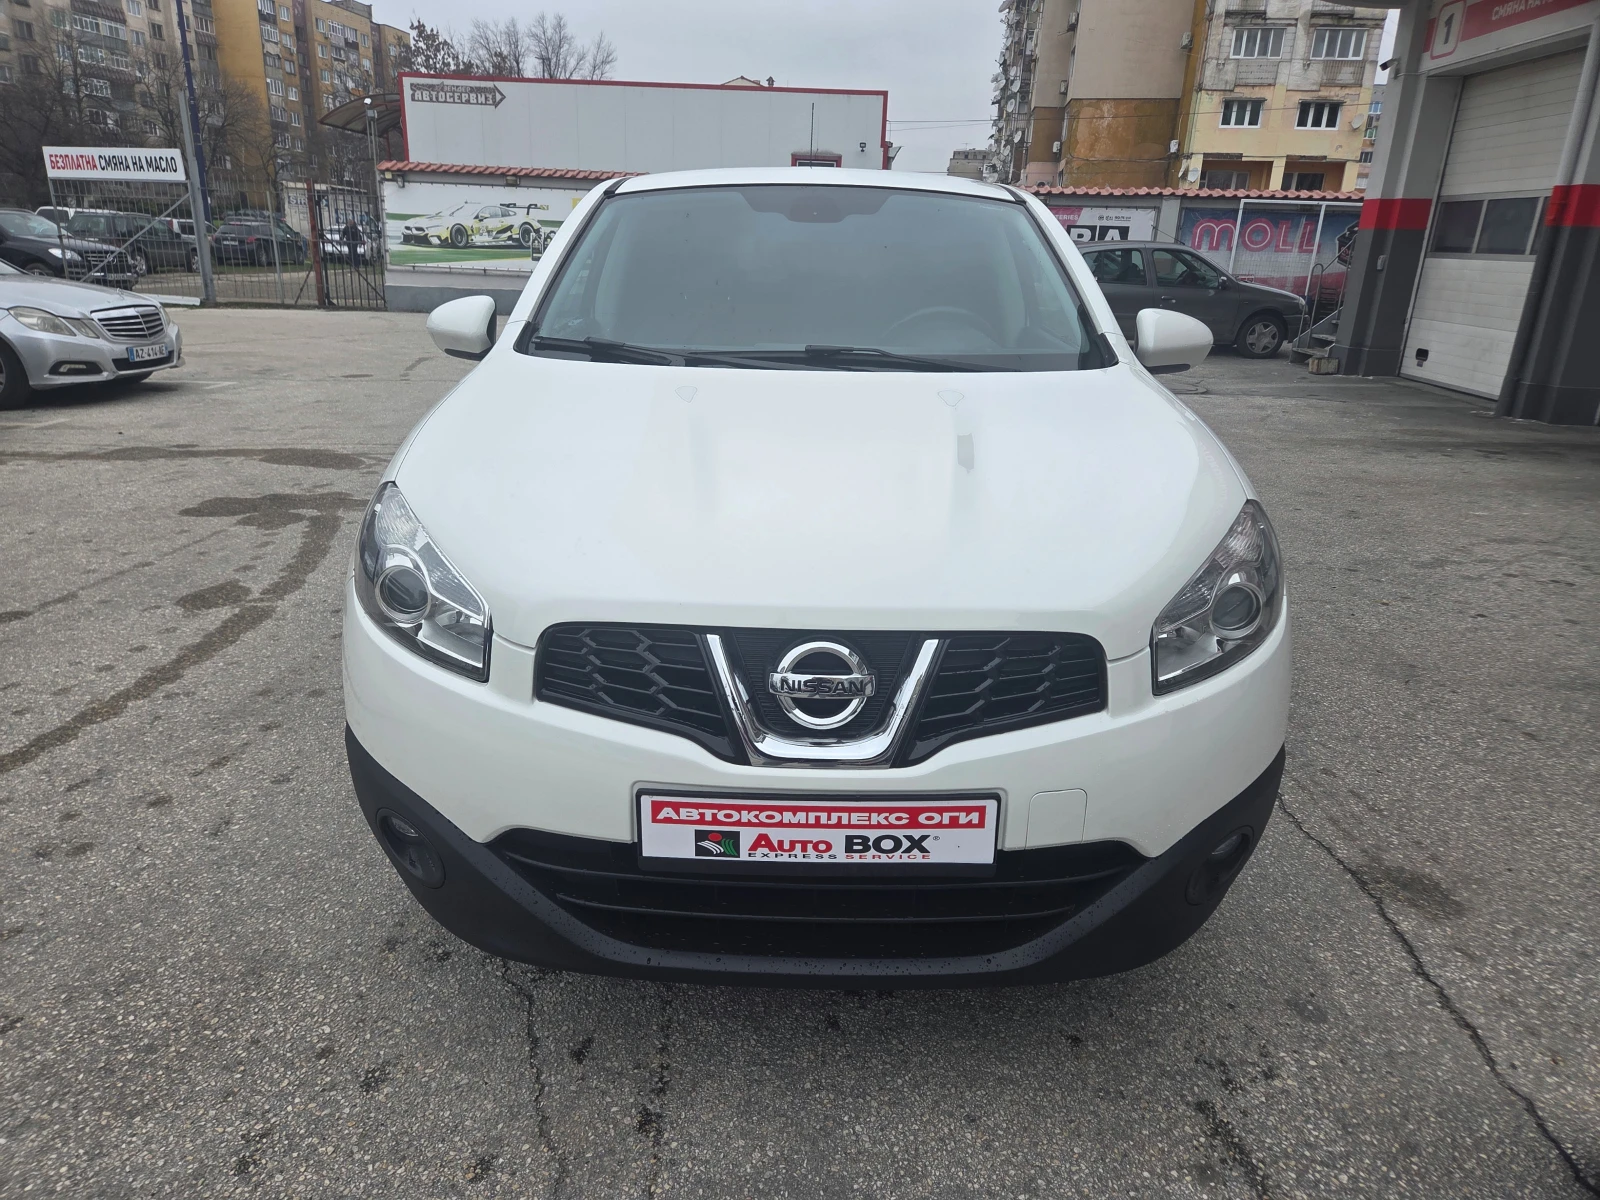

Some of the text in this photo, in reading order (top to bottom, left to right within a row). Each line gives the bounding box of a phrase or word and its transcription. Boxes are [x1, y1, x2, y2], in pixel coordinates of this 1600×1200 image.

[1443, 12, 1455, 45] 1
[414, 90, 493, 104] АВТОСЕРВИЗ
[48, 153, 177, 173] БЕЗПЛАТНА СМЯНА НА МАСЛО
[1190, 218, 1322, 253] MOLL
[780, 677, 864, 695] NISSAN
[656, 807, 980, 825] АВТОКОМПЛЕКС ОГИ
[747, 852, 837, 860] EXPRESS
